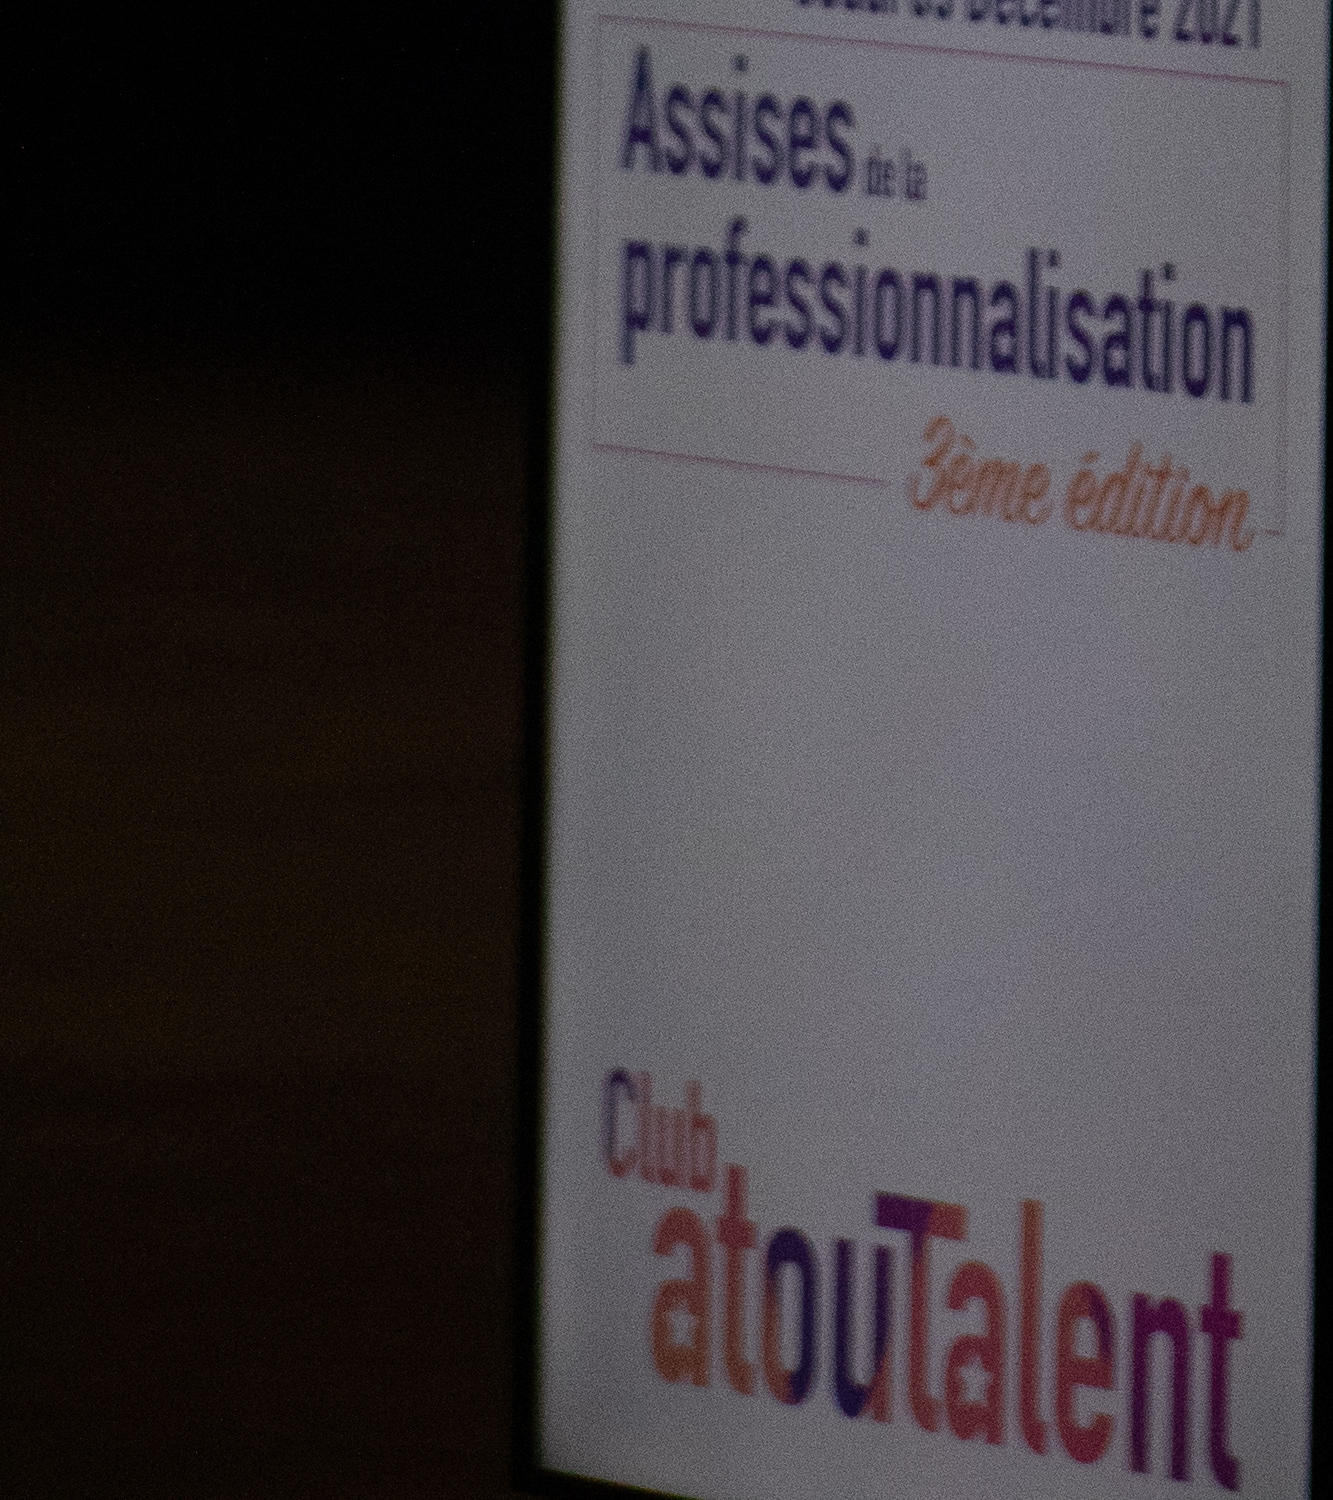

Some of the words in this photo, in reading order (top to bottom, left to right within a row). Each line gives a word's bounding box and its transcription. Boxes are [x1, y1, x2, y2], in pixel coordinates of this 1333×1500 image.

[620, 44, 854, 193] Assises
[866, 146, 895, 198] de
[905, 147, 928, 201] la
[620, 214, 1254, 404] professionnalisation
[906, 415, 1051, 526] 3ème
[1064, 440, 1255, 553] édition
[602, 1069, 718, 1193] Club
[651, 1162, 1243, 1492] atouTalent
